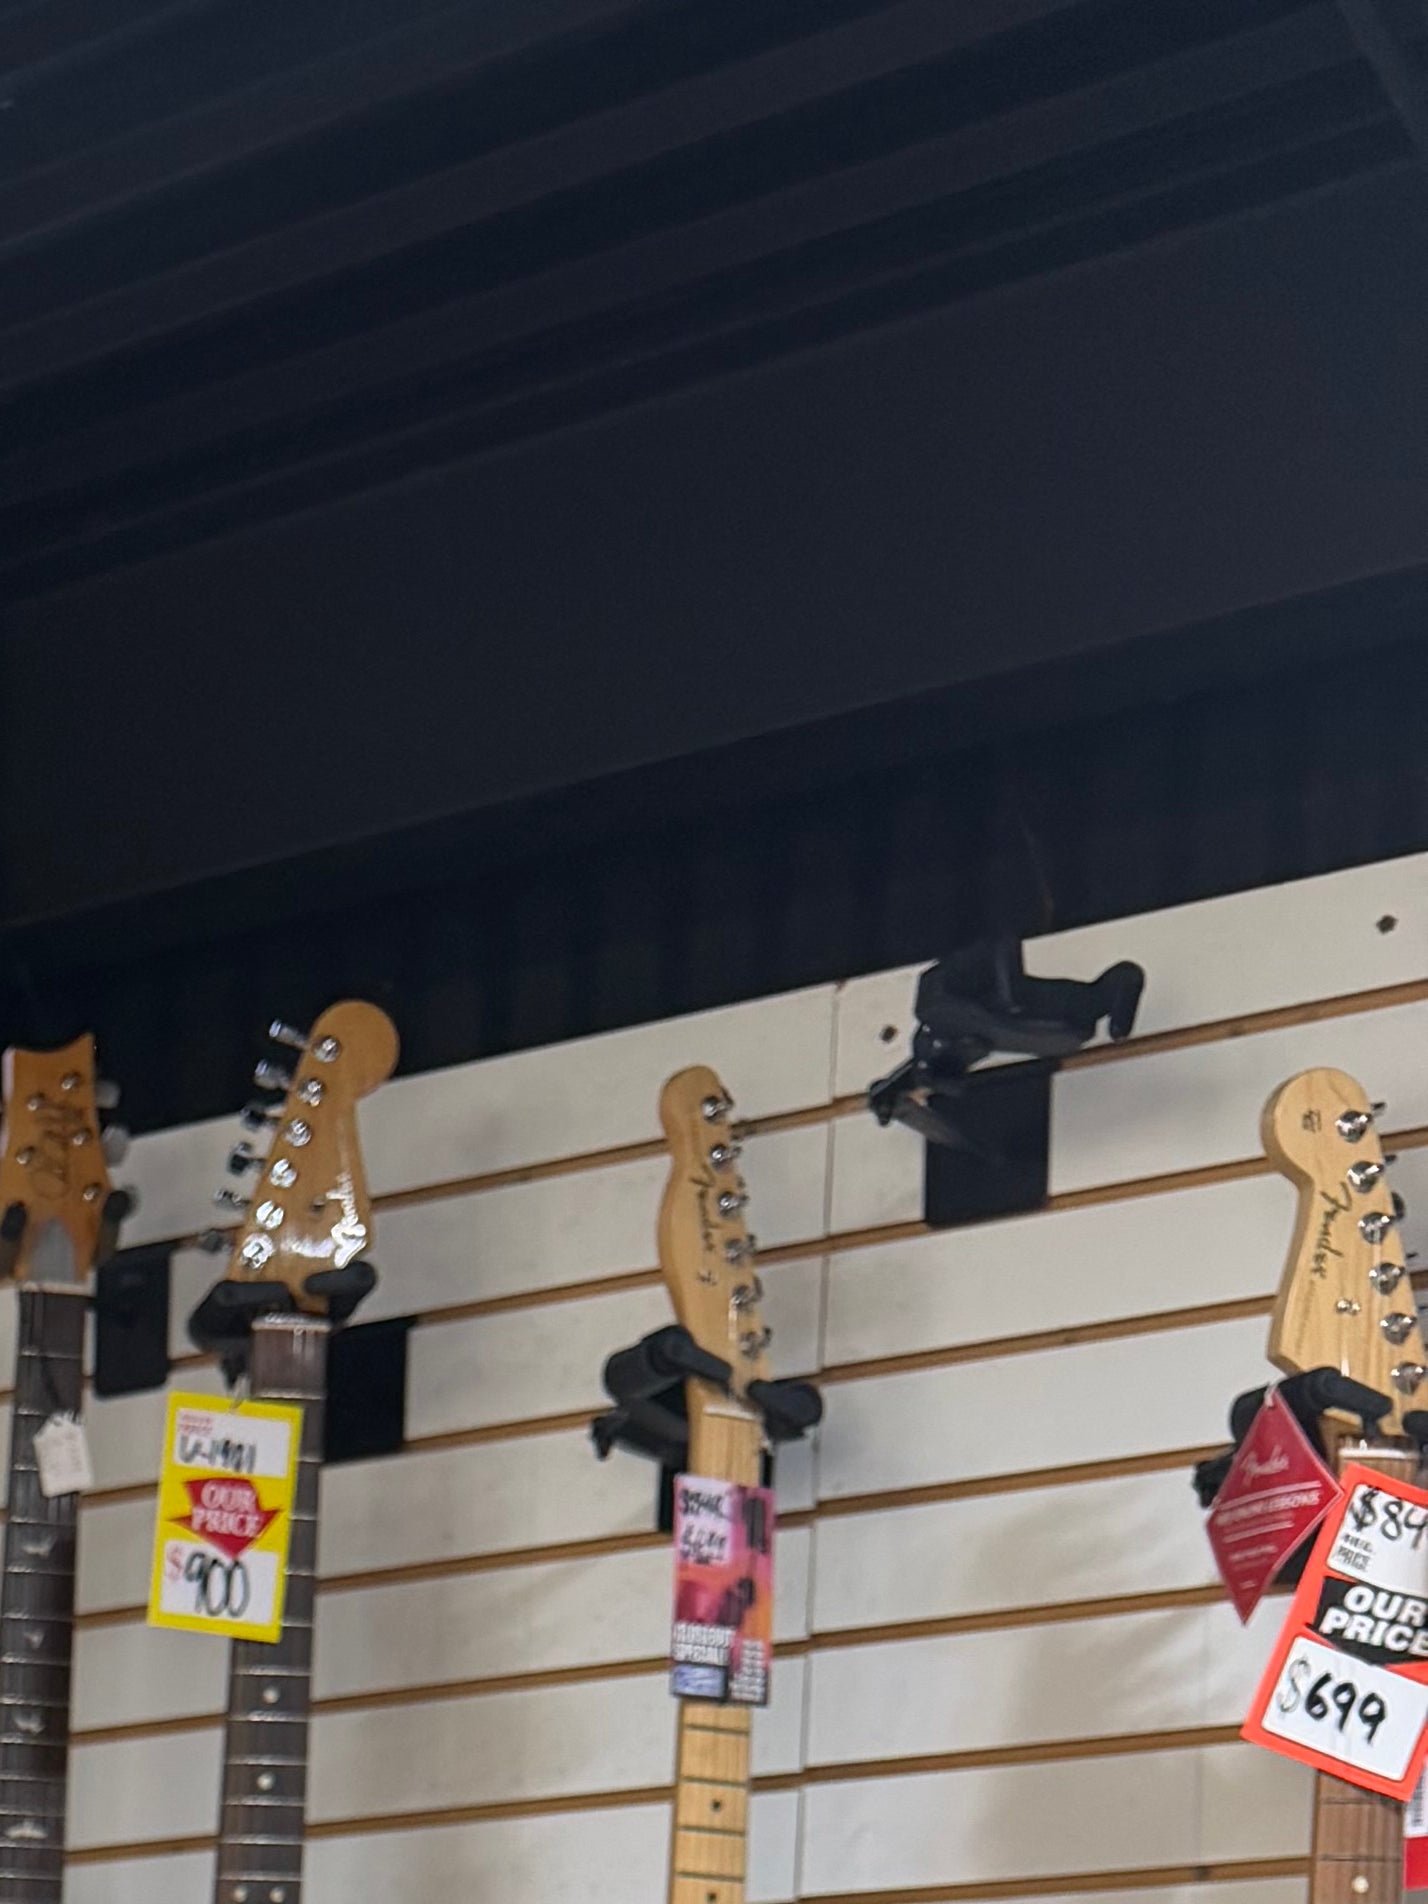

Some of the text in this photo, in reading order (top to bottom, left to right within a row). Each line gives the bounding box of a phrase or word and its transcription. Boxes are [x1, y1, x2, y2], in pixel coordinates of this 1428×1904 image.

[1317, 1182, 1353, 1280] Fender
[191, 1507, 262, 1539] PRICE
[1344, 1585, 1428, 1627] OUR
